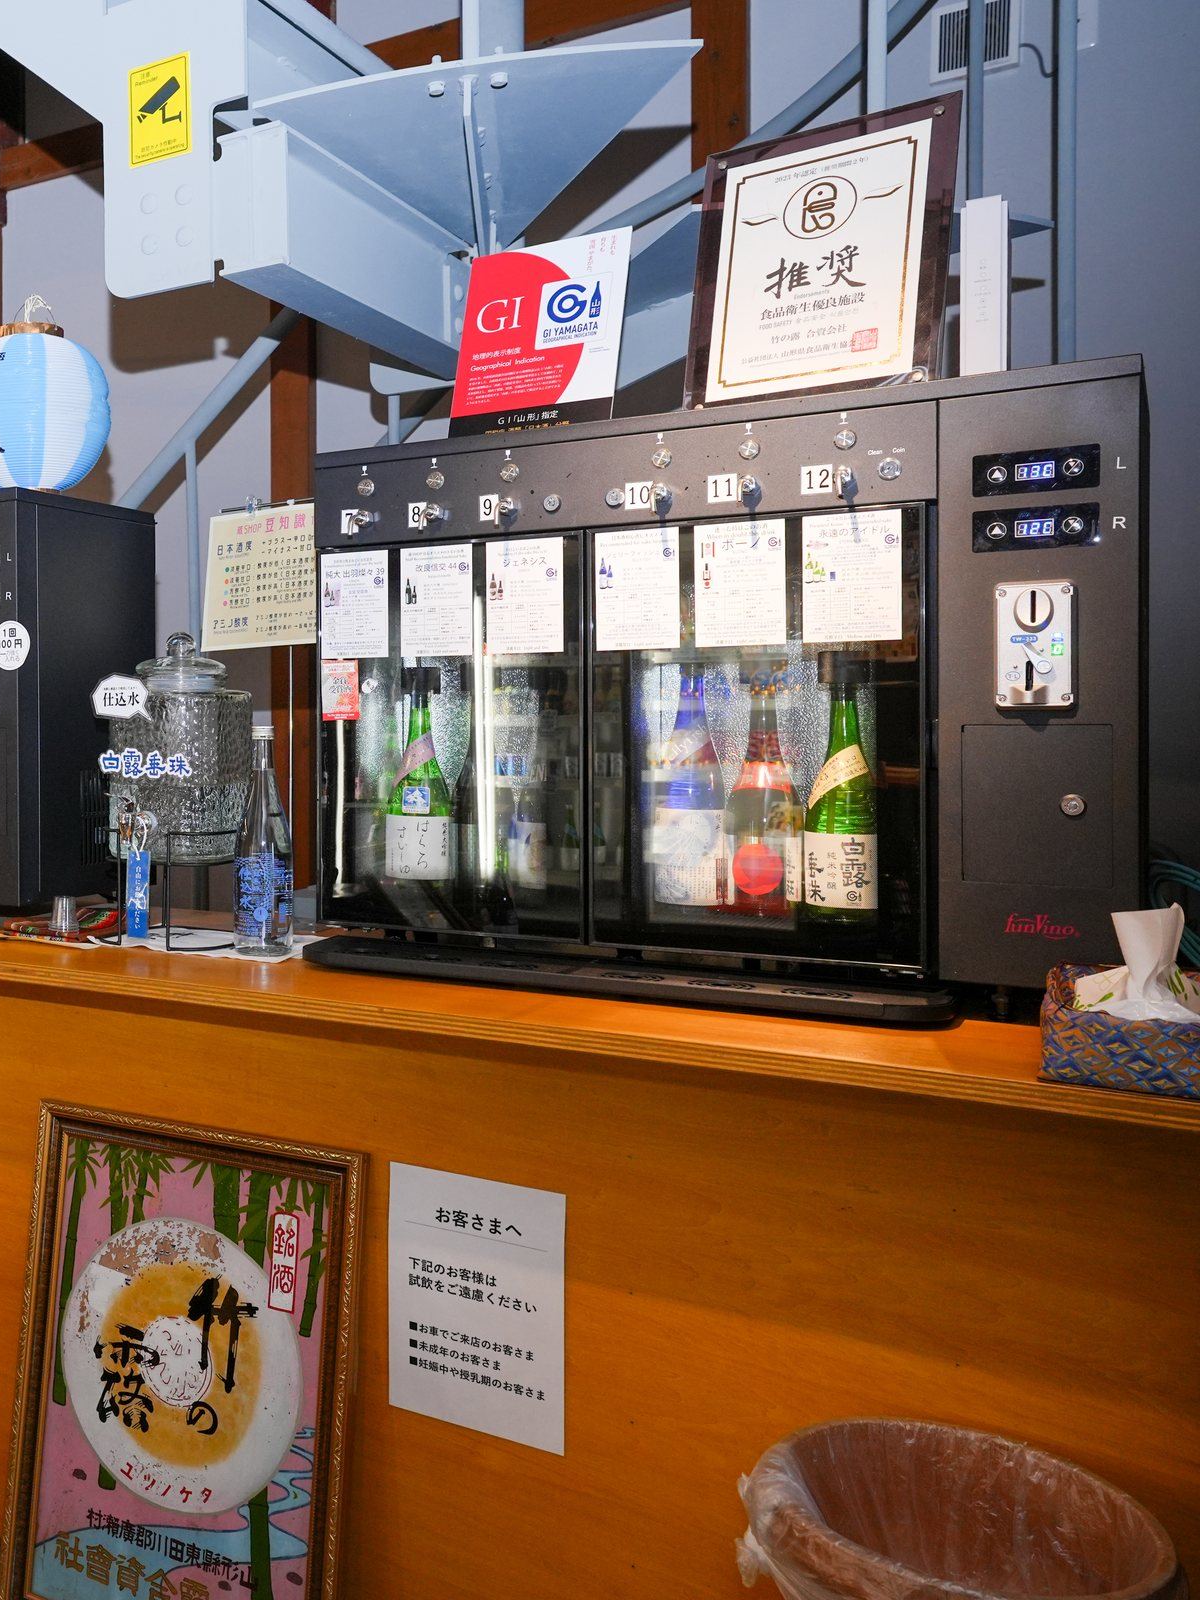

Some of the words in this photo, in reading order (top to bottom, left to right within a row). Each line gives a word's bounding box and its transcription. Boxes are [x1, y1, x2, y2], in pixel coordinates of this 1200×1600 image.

[764, 245, 866, 299] 推奨
[476, 295, 525, 333] GI
[760, 292, 867, 321] 食品衛生優良施設
[542, 328, 553, 339] GI
[554, 321, 598, 336] YAMAGATA
[771, 331, 801, 345] 竹の露
[470, 360, 512, 372] Geographical
[514, 355, 545, 366] Indication
[892, 446, 906, 454] Coin
[1115, 456, 1127, 470] L
[711, 478, 733, 498] 11
[805, 469, 830, 489] 12
[629, 486, 650, 505] 10
[411, 506, 421, 523] 8
[482, 498, 493, 517] 9
[265, 513, 314, 534] 豆知識
[1112, 516, 1127, 530] R
[6, 552, 12, 562] L
[217, 540, 252, 556] 日本酒度
[376, 567, 385, 575] 39
[503, 556, 547, 567] ジェネシス
[5, 592, 12, 601] R
[2, 628, 17, 638] 1回
[103, 691, 140, 707] 仕込水
[101, 750, 191, 777] 白露垂珠
[826, 851, 838, 890] 純米吟醸
[840, 837, 871, 889] 白露
[1004, 912, 1075, 940] funVino
[435, 1206, 523, 1237] お客さまへ
[272, 1224, 296, 1294] 銘酒
[408, 1256, 497, 1288] 下記のお客様は
[408, 1273, 538, 1314] 試飲をご遠慮ください
